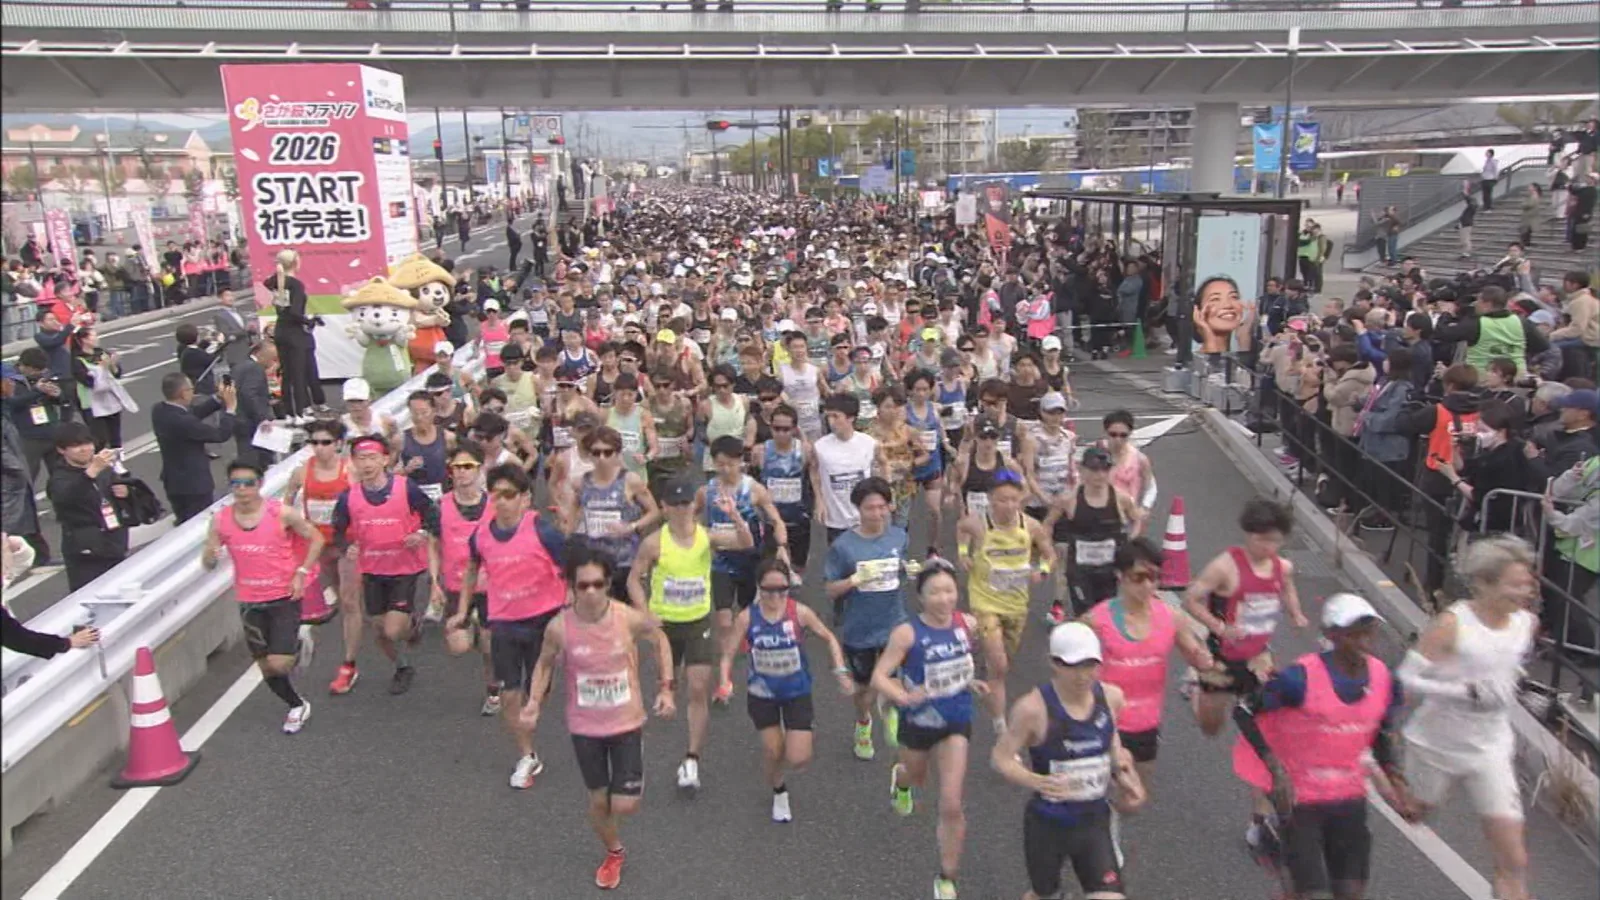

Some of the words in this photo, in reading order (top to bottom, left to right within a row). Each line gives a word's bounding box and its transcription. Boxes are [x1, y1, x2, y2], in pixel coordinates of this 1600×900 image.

[273, 136, 336, 161] 2026
[256, 176, 359, 204] START
[259, 209, 366, 240] 祈完走!
